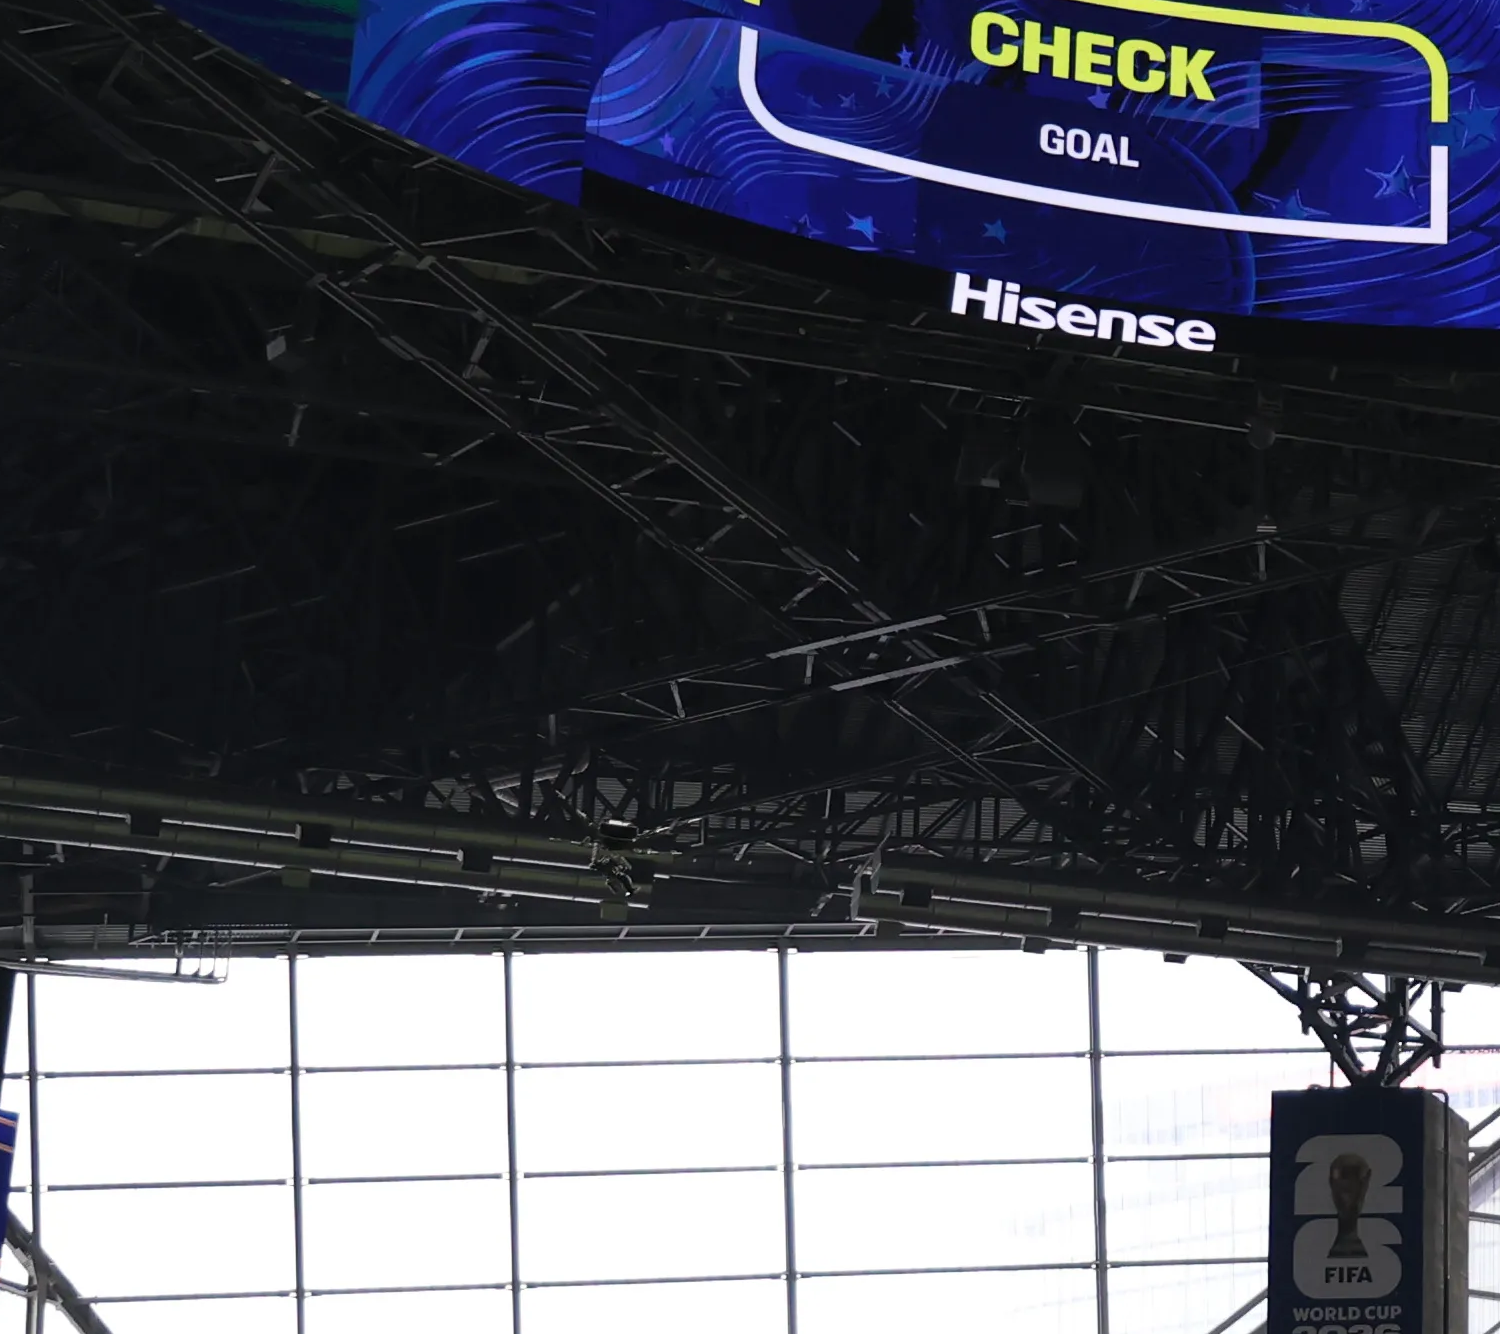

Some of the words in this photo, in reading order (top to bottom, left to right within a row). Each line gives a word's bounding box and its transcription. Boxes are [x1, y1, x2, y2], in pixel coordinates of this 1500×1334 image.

[971, 11, 1215, 102] CHECK
[1039, 123, 1139, 170] GOAL
[951, 271, 1216, 353] Hisense
[1325, 1266, 1373, 1284] FIFA
[1292, 1306, 1365, 1322] WORLD
[1367, 1305, 1402, 1321] CUP
